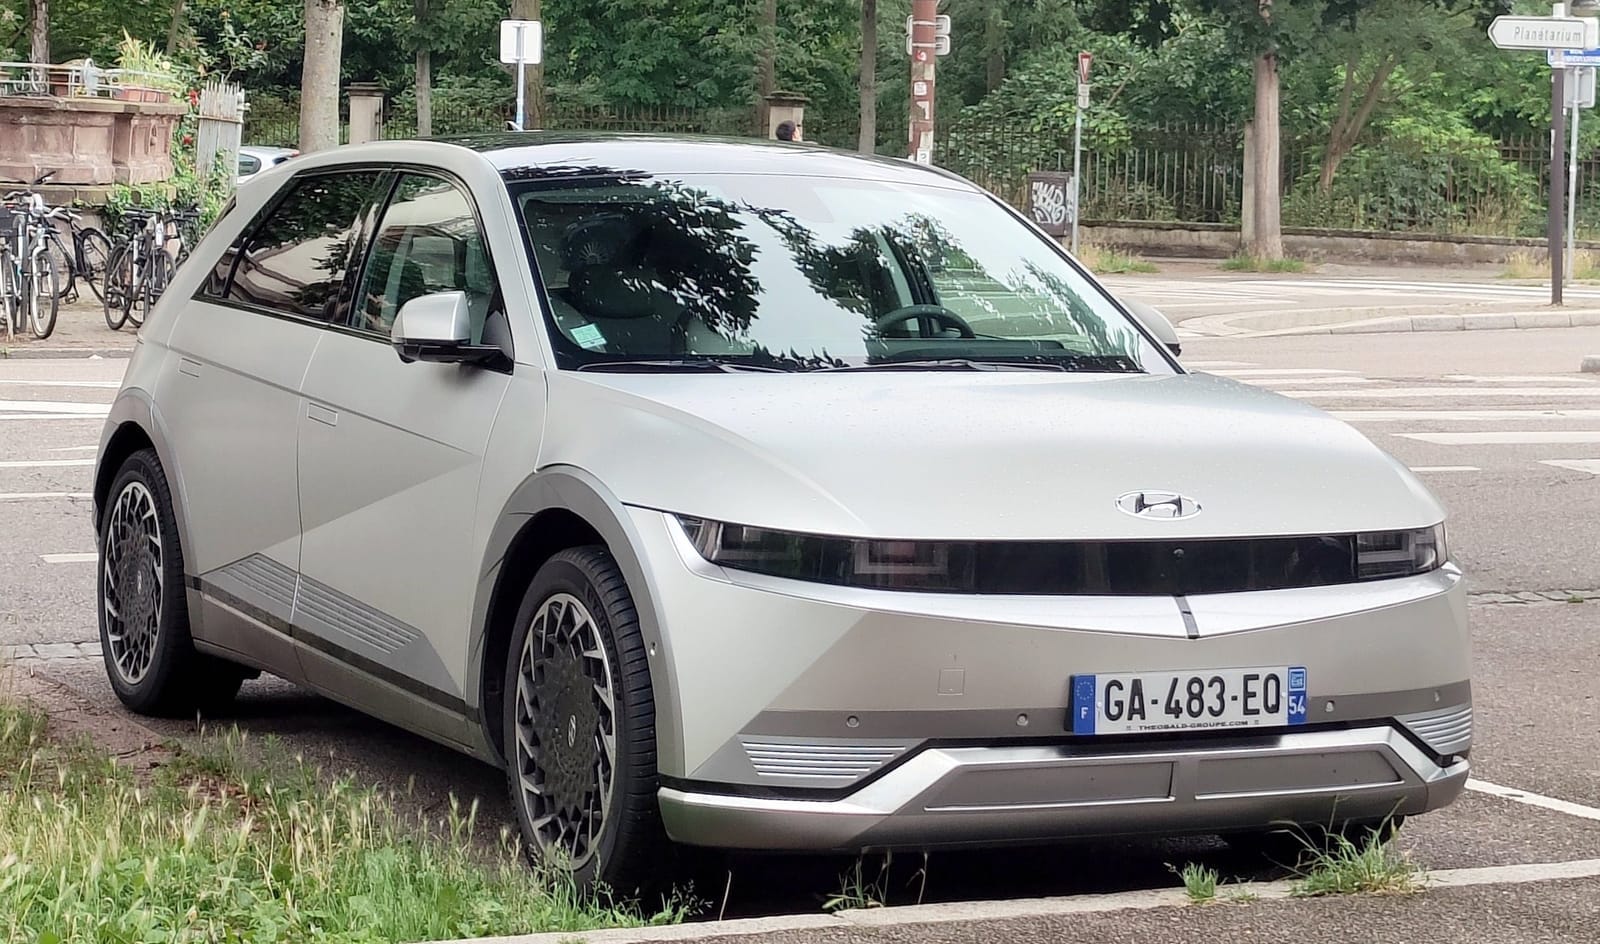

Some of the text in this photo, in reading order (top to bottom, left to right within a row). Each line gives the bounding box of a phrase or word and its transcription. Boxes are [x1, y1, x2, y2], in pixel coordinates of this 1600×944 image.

[1514, 26, 1581, 41] Planétarium
[1104, 673, 1281, 722] GA-483-EQ
[1288, 695, 1306, 715] 54
[1080, 706, 1088, 719] F
[1138, 720, 1249, 731] THEOBALD-GROUPE.COM
